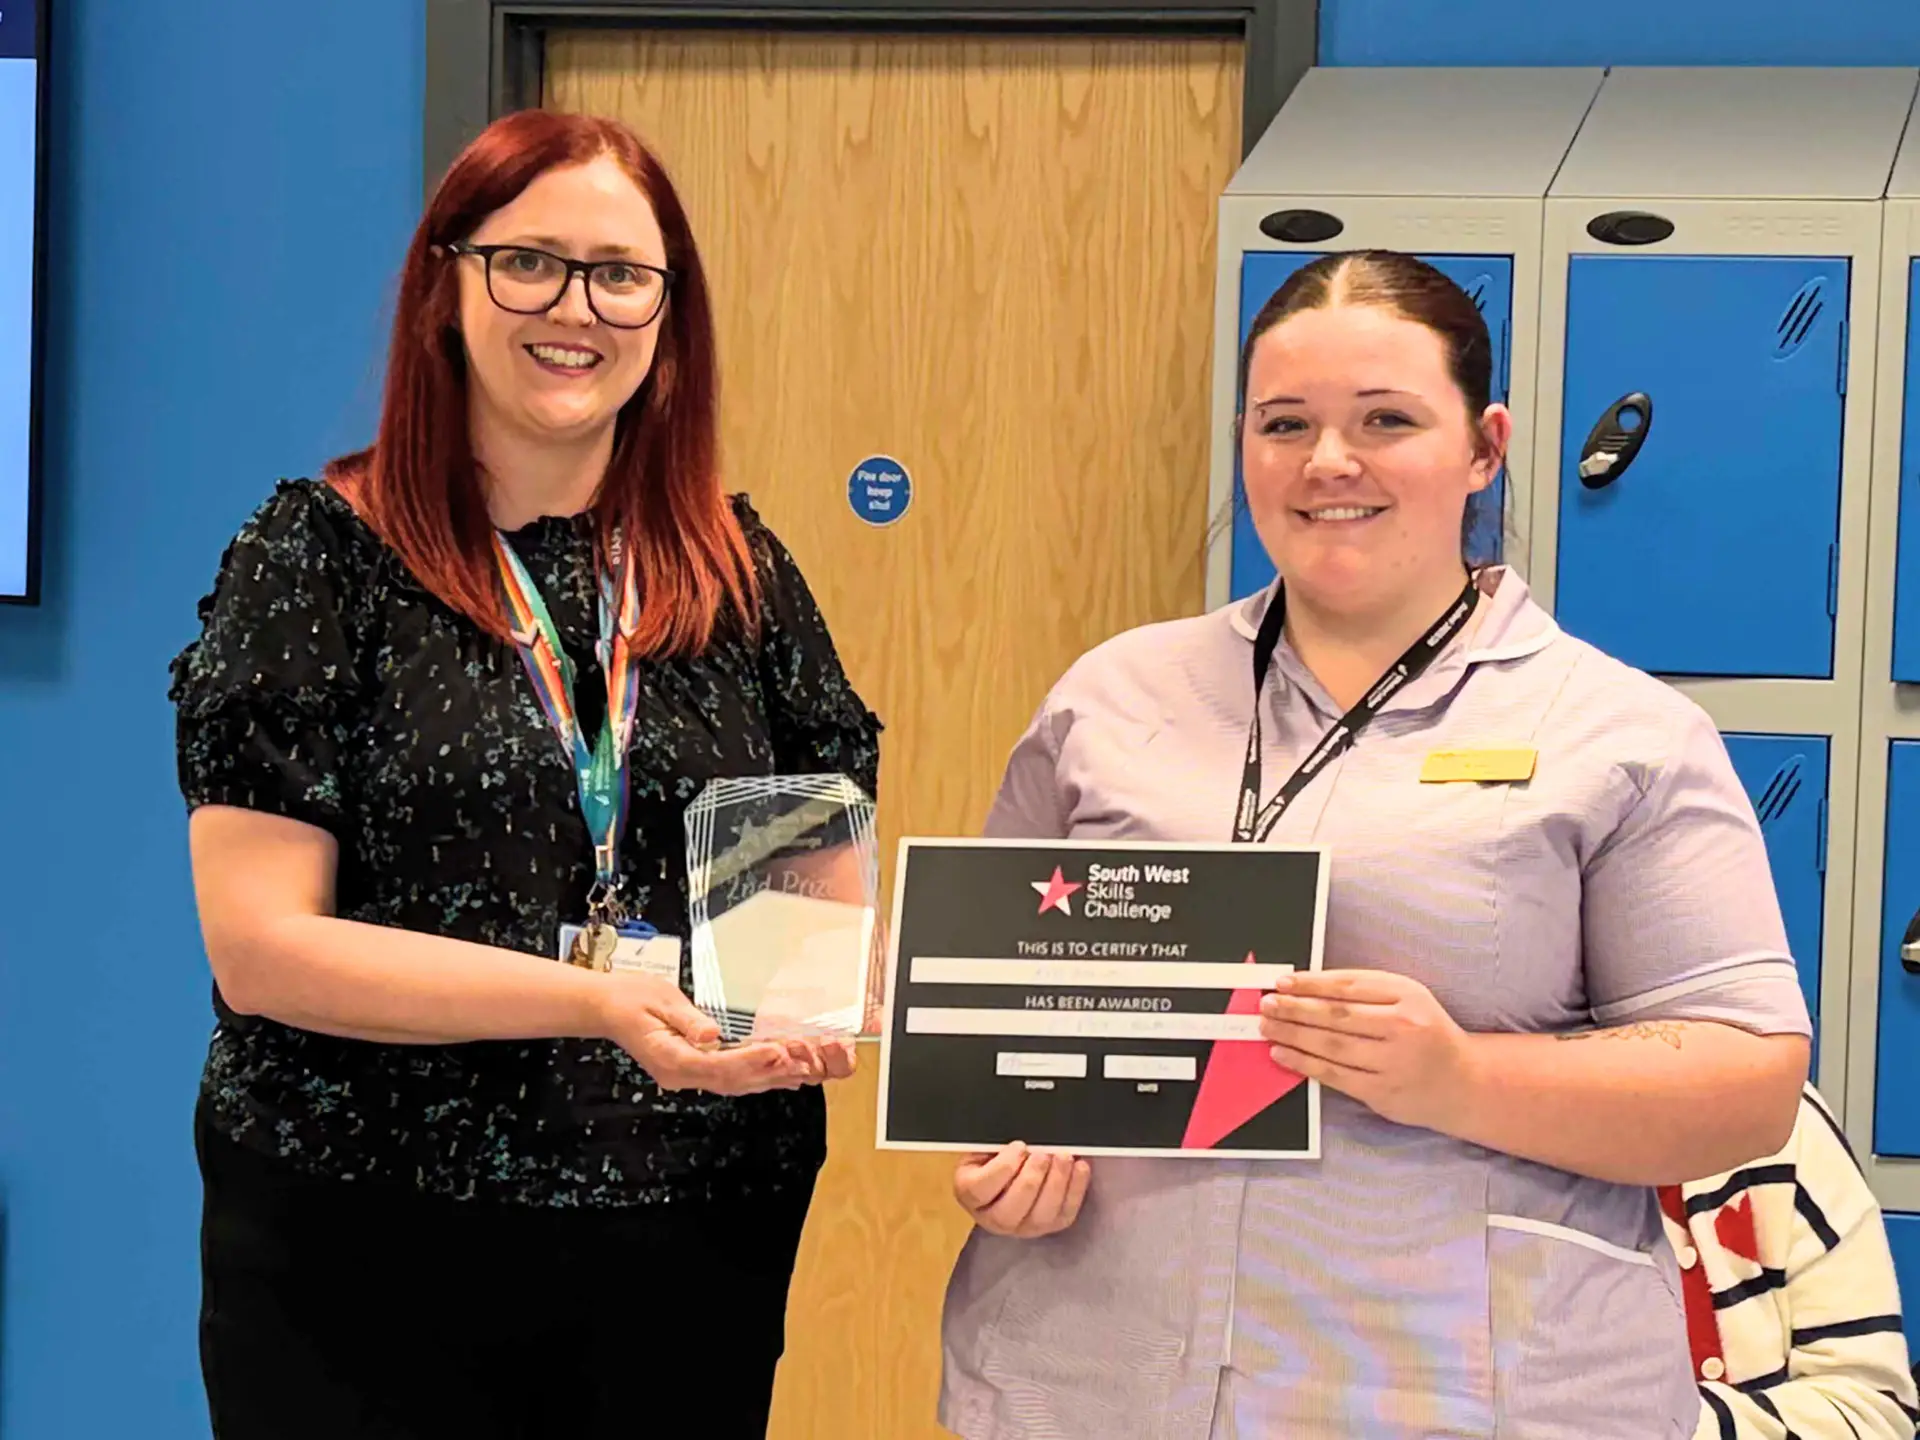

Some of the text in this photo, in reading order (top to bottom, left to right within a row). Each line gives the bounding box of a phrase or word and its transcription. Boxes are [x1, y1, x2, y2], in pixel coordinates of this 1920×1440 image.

[1088, 863, 1190, 884] South West
[1086, 882, 1135, 900] Skills
[1084, 900, 1172, 923] Challenge
[1017, 941, 1188, 957] THIS IS TO CERTIFY THAT
[1025, 996, 1172, 1011] HAS BEEN AWARDED
